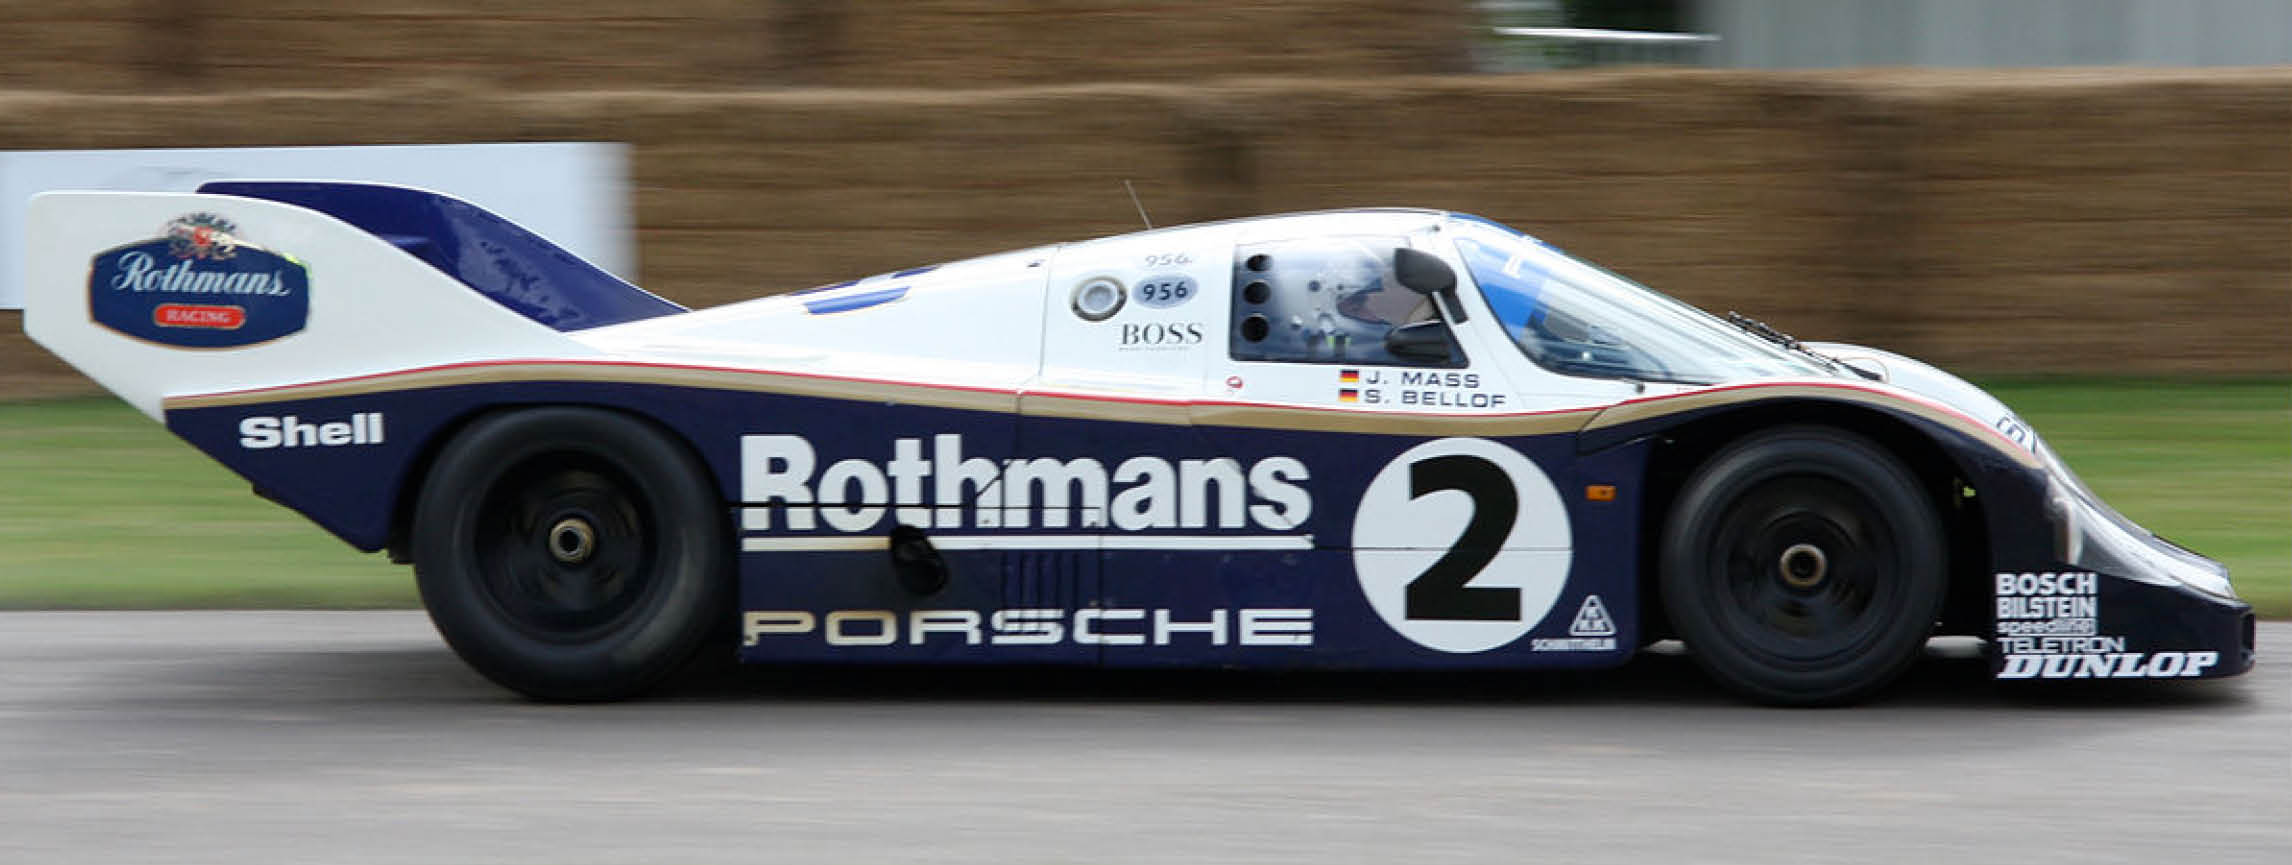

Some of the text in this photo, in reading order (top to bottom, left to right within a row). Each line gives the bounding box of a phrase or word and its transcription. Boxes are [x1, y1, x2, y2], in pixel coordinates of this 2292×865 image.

[111, 251, 290, 296] Rothmans
[1143, 281, 1189, 302] 956
[166, 308, 232, 324] RACING
[1121, 322, 1203, 345] BOSS
[1366, 370, 1480, 389] J. MASS
[1364, 389, 1506, 408] S. BELLOF
[239, 413, 384, 449] Shell
[740, 433, 1313, 531] Rothmans
[1405, 454, 1522, 621] 2
[1996, 573, 2097, 596] BOSCH
[1996, 596, 2097, 619] BILSTEIN
[742, 608, 1315, 646] PORSCHE
[1996, 636, 2125, 654] TELETRON
[1997, 652, 2219, 679] DUNLOP
